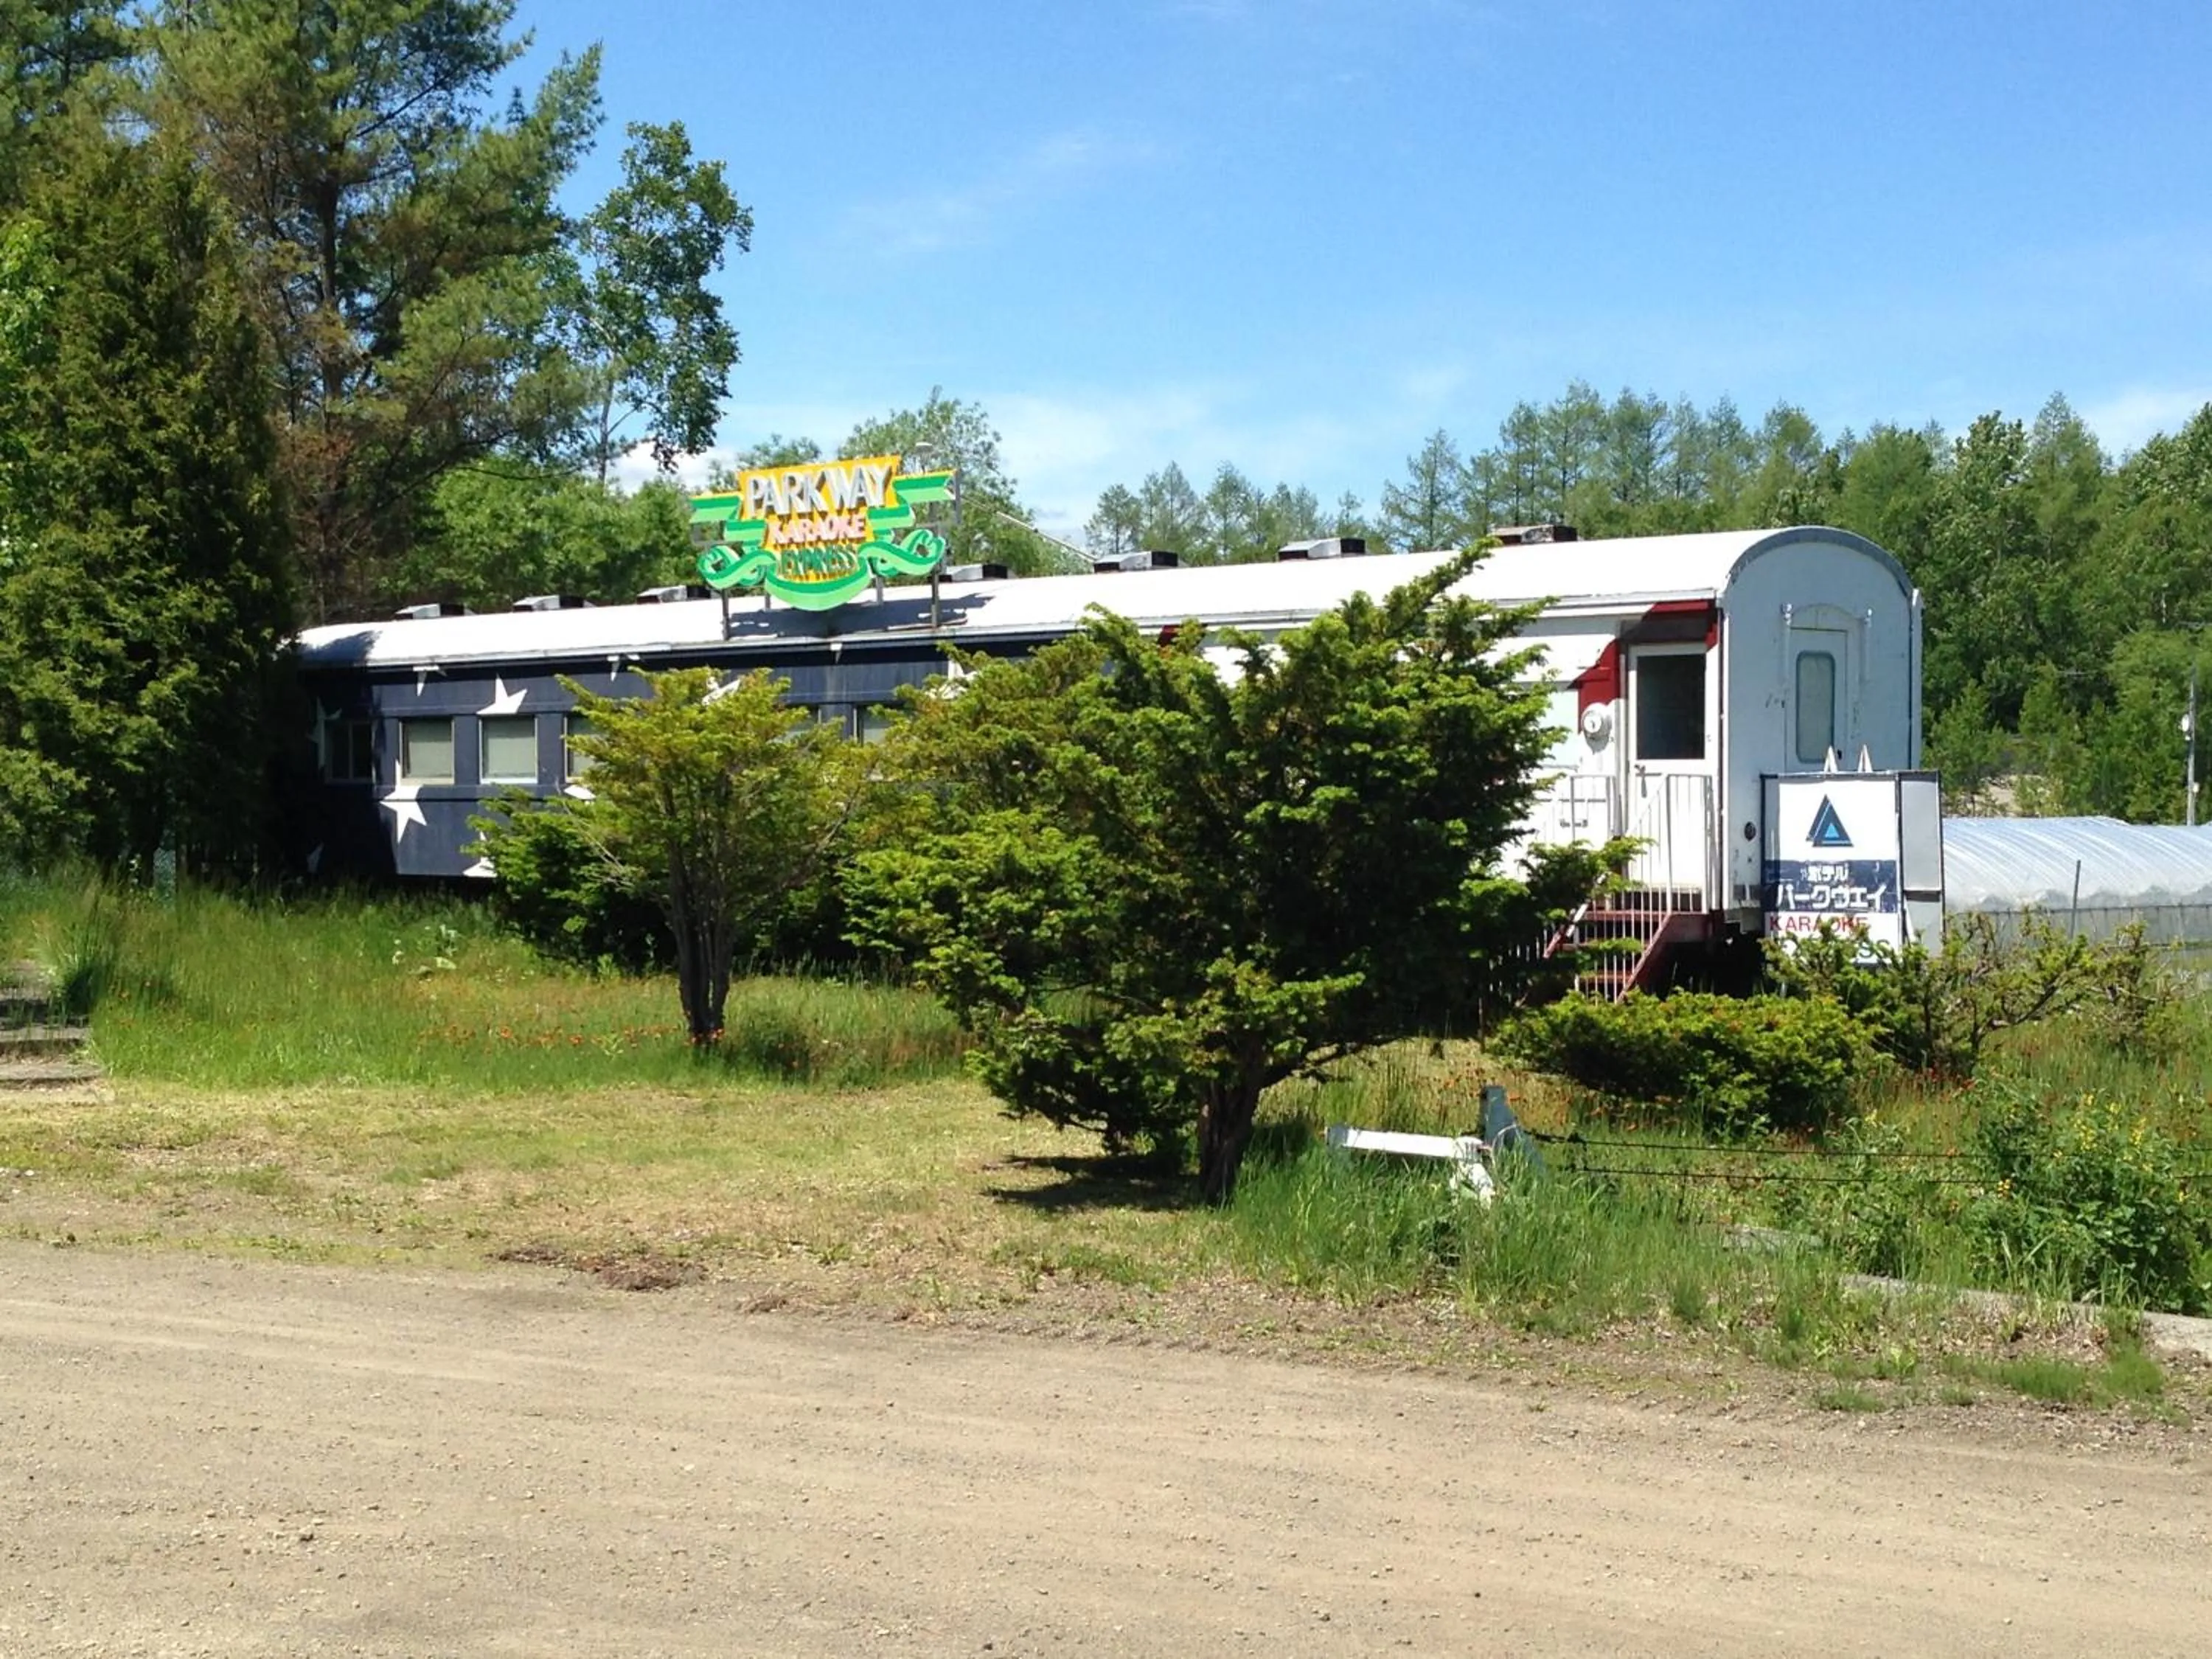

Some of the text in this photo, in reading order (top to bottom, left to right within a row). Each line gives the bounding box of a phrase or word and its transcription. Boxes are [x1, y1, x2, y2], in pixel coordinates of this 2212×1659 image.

[768, 515, 866, 544] KARAOKE
[1807, 863, 1849, 882] ホテル
